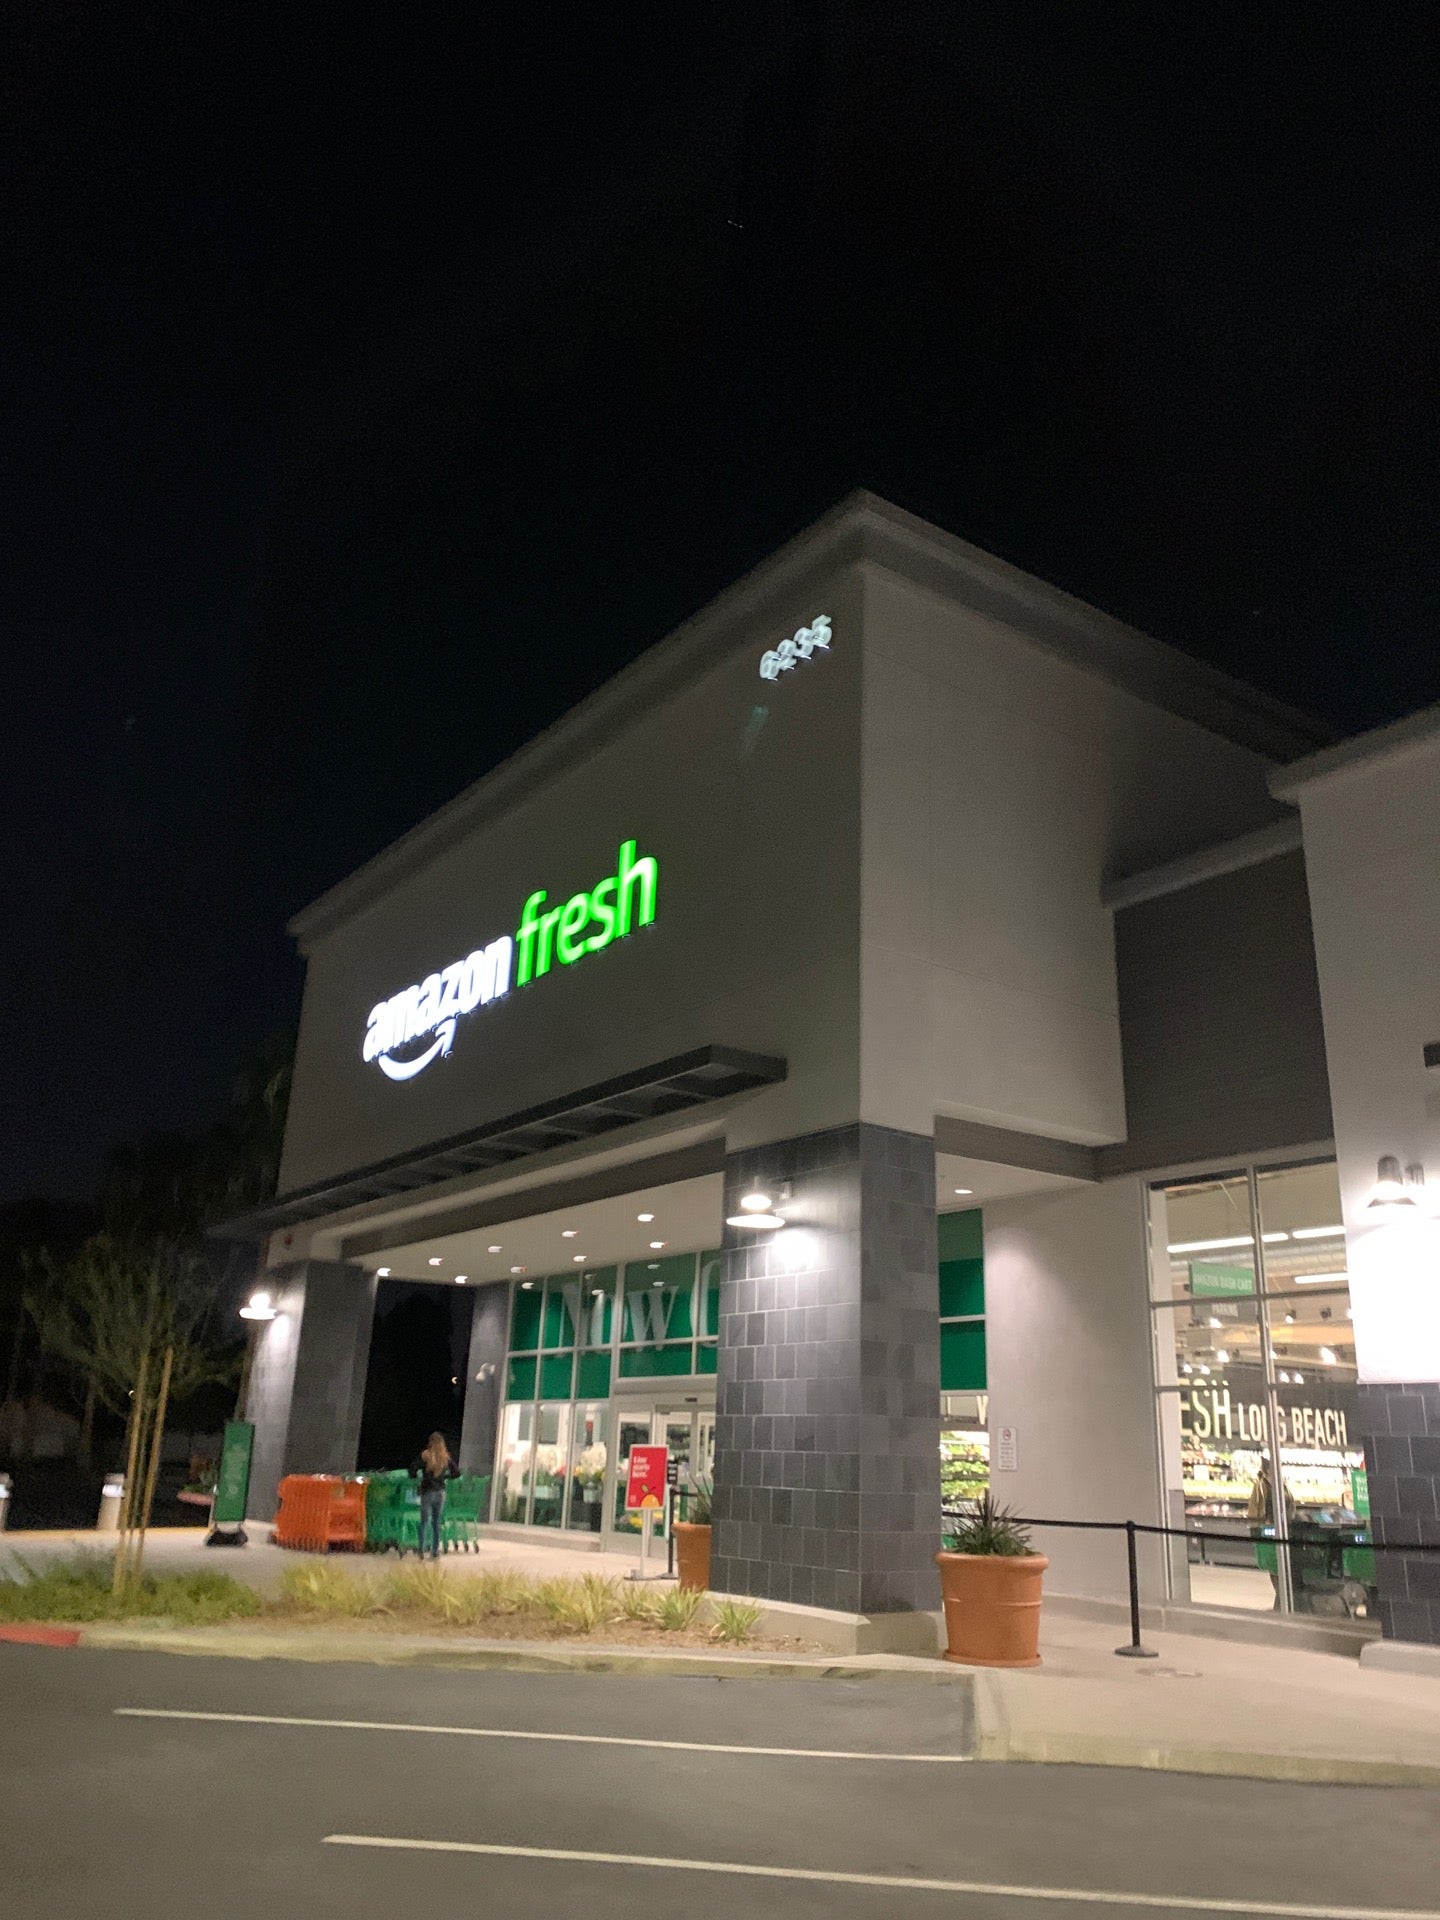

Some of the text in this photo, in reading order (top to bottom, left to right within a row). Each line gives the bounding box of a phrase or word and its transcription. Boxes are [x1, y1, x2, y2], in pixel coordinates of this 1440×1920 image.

[363, 839, 658, 1062] amazon fresh
[1291, 1406, 1348, 1447] BEACH
